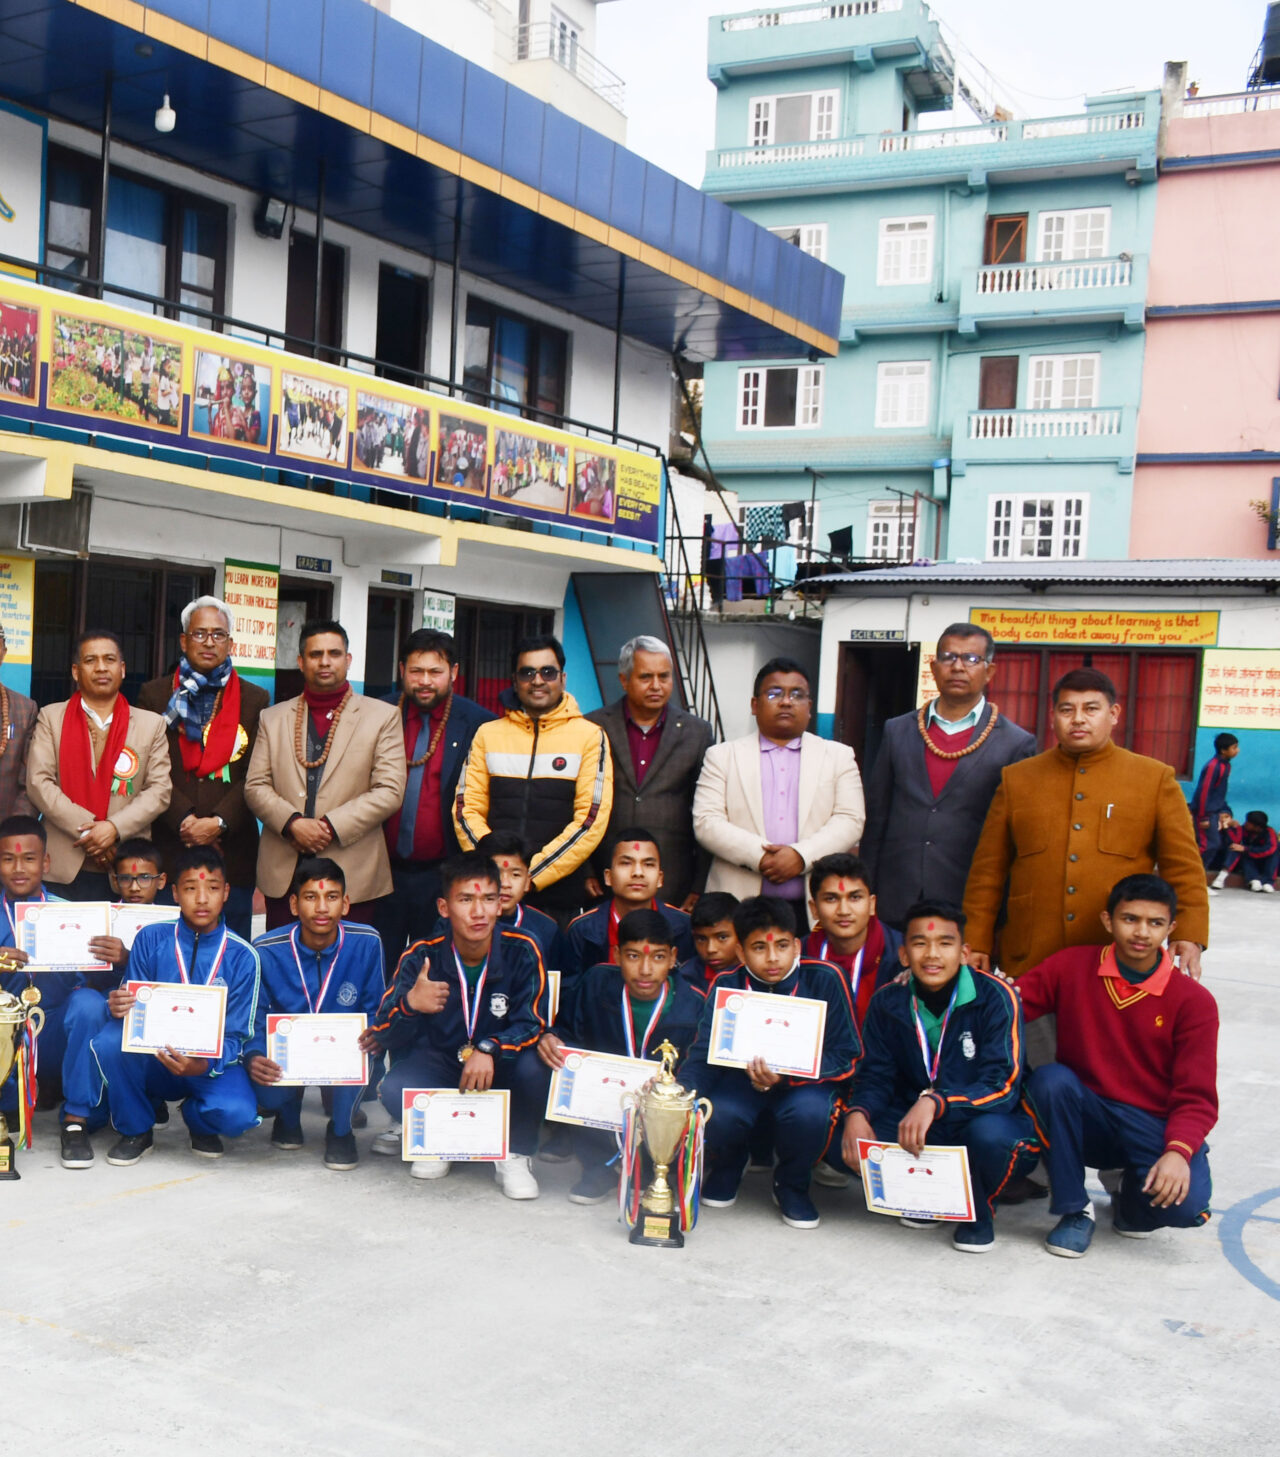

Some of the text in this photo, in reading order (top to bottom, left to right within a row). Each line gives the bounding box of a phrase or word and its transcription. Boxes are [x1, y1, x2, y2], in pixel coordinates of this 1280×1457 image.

[234, 573, 249, 586] LEARN
[251, 574, 264, 588] MORE
[265, 576, 278, 589] FROM
[236, 617, 245, 632] LET
[252, 619, 265, 635] STOP
[1000, 613, 1046, 627] beautiful
[1048, 613, 1077, 628] thing
[1081, 613, 1113, 627] about
[1115, 613, 1161, 632] learning
[1164, 617, 1174, 627] is
[1175, 614, 1200, 627] that
[852, 630, 887, 641] SCIENCE
[1024, 631, 1049, 640] can
[1091, 632, 1120, 645] away
[1121, 628, 1155, 645] from
